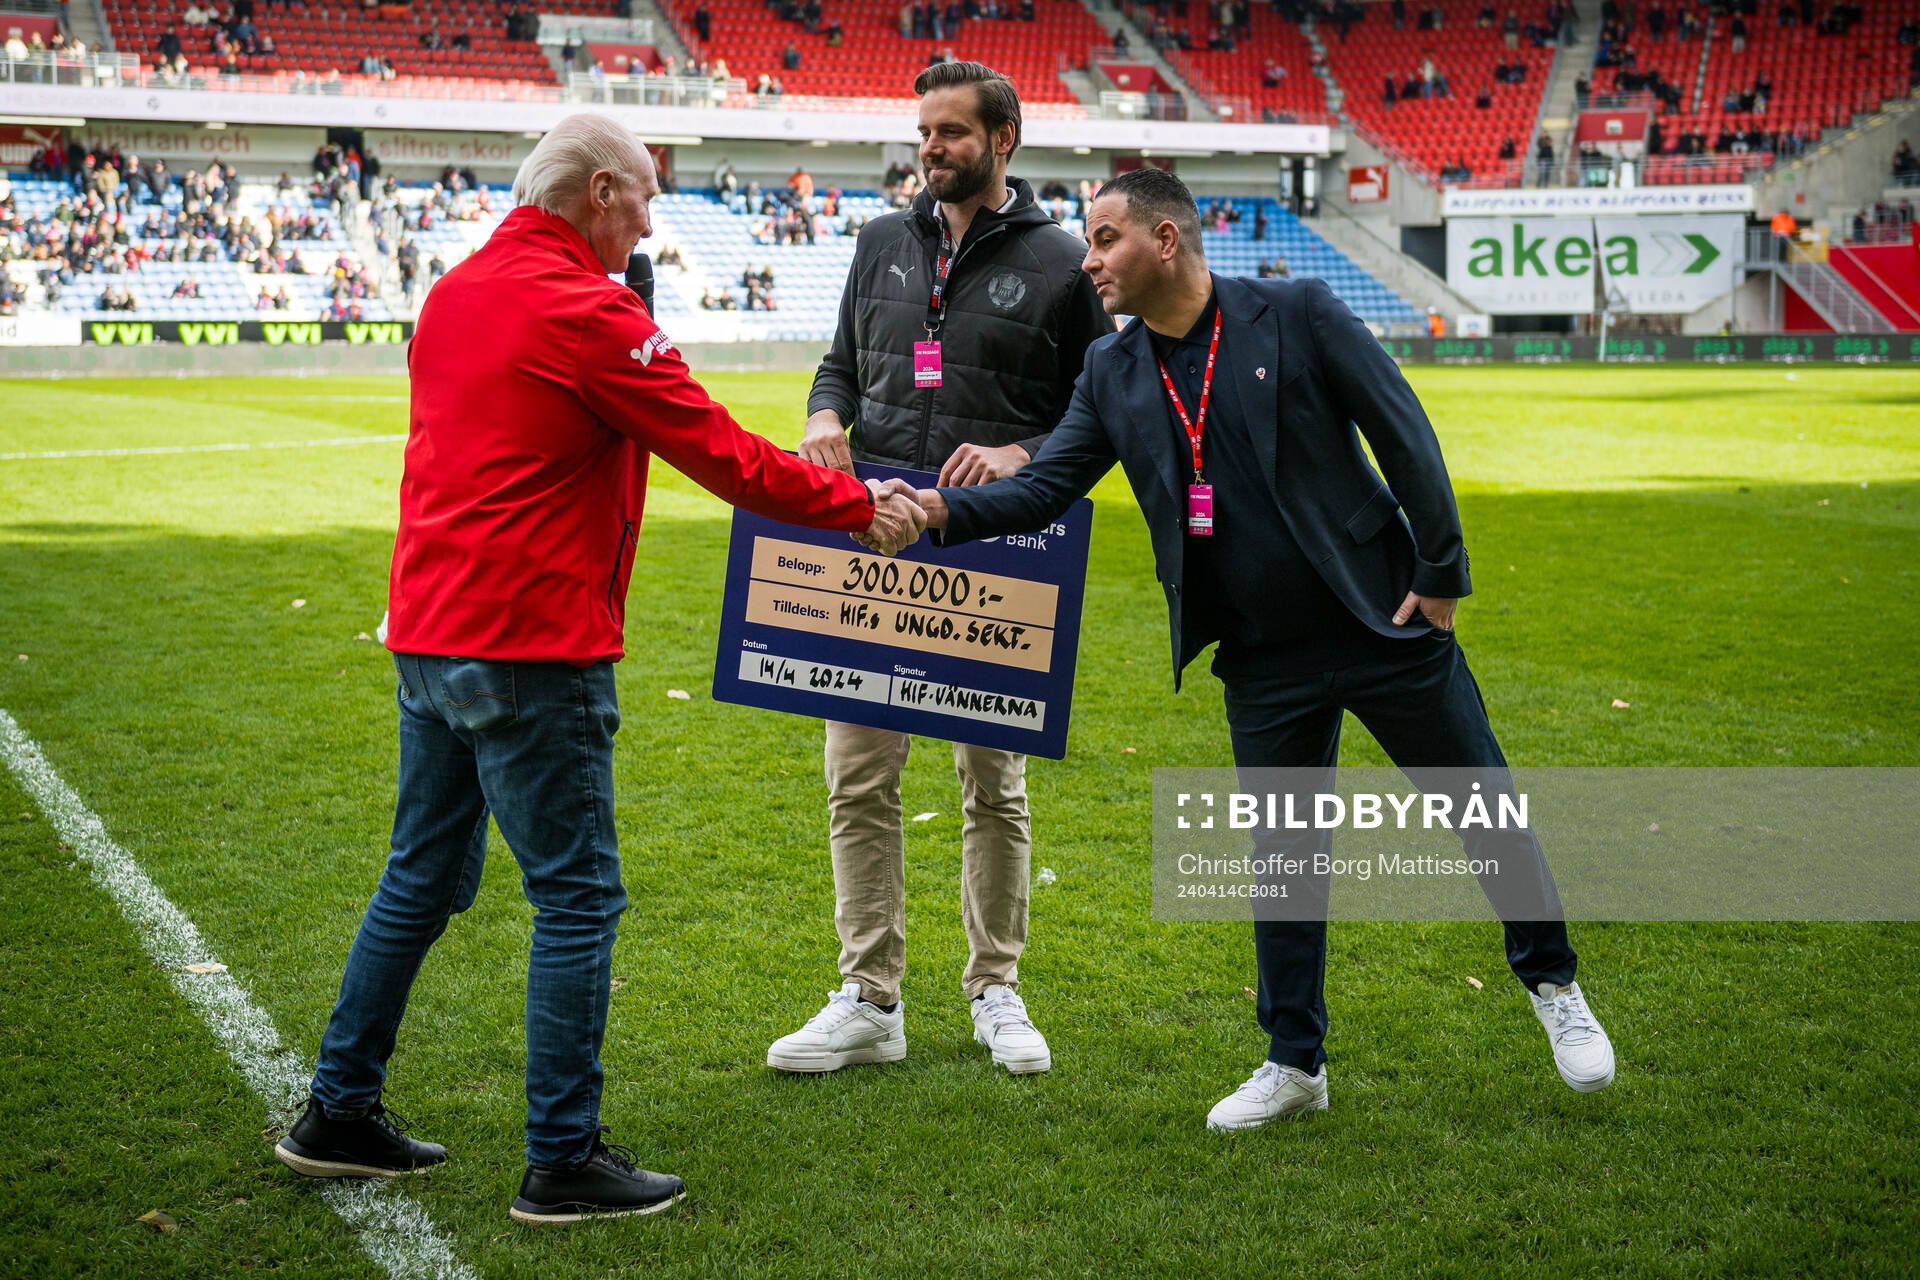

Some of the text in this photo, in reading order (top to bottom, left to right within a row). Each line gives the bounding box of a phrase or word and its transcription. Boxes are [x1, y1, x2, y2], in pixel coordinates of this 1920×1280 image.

[1467, 223, 1639, 277] akea
[1006, 534, 1047, 551] Bank
[777, 556, 826, 575] Belopp:
[773, 600, 830, 620] Tilldelas:
[742, 639, 768, 651] Datum
[759, 657, 864, 692] 14/4 2024
[894, 665, 927, 678] Signatur
